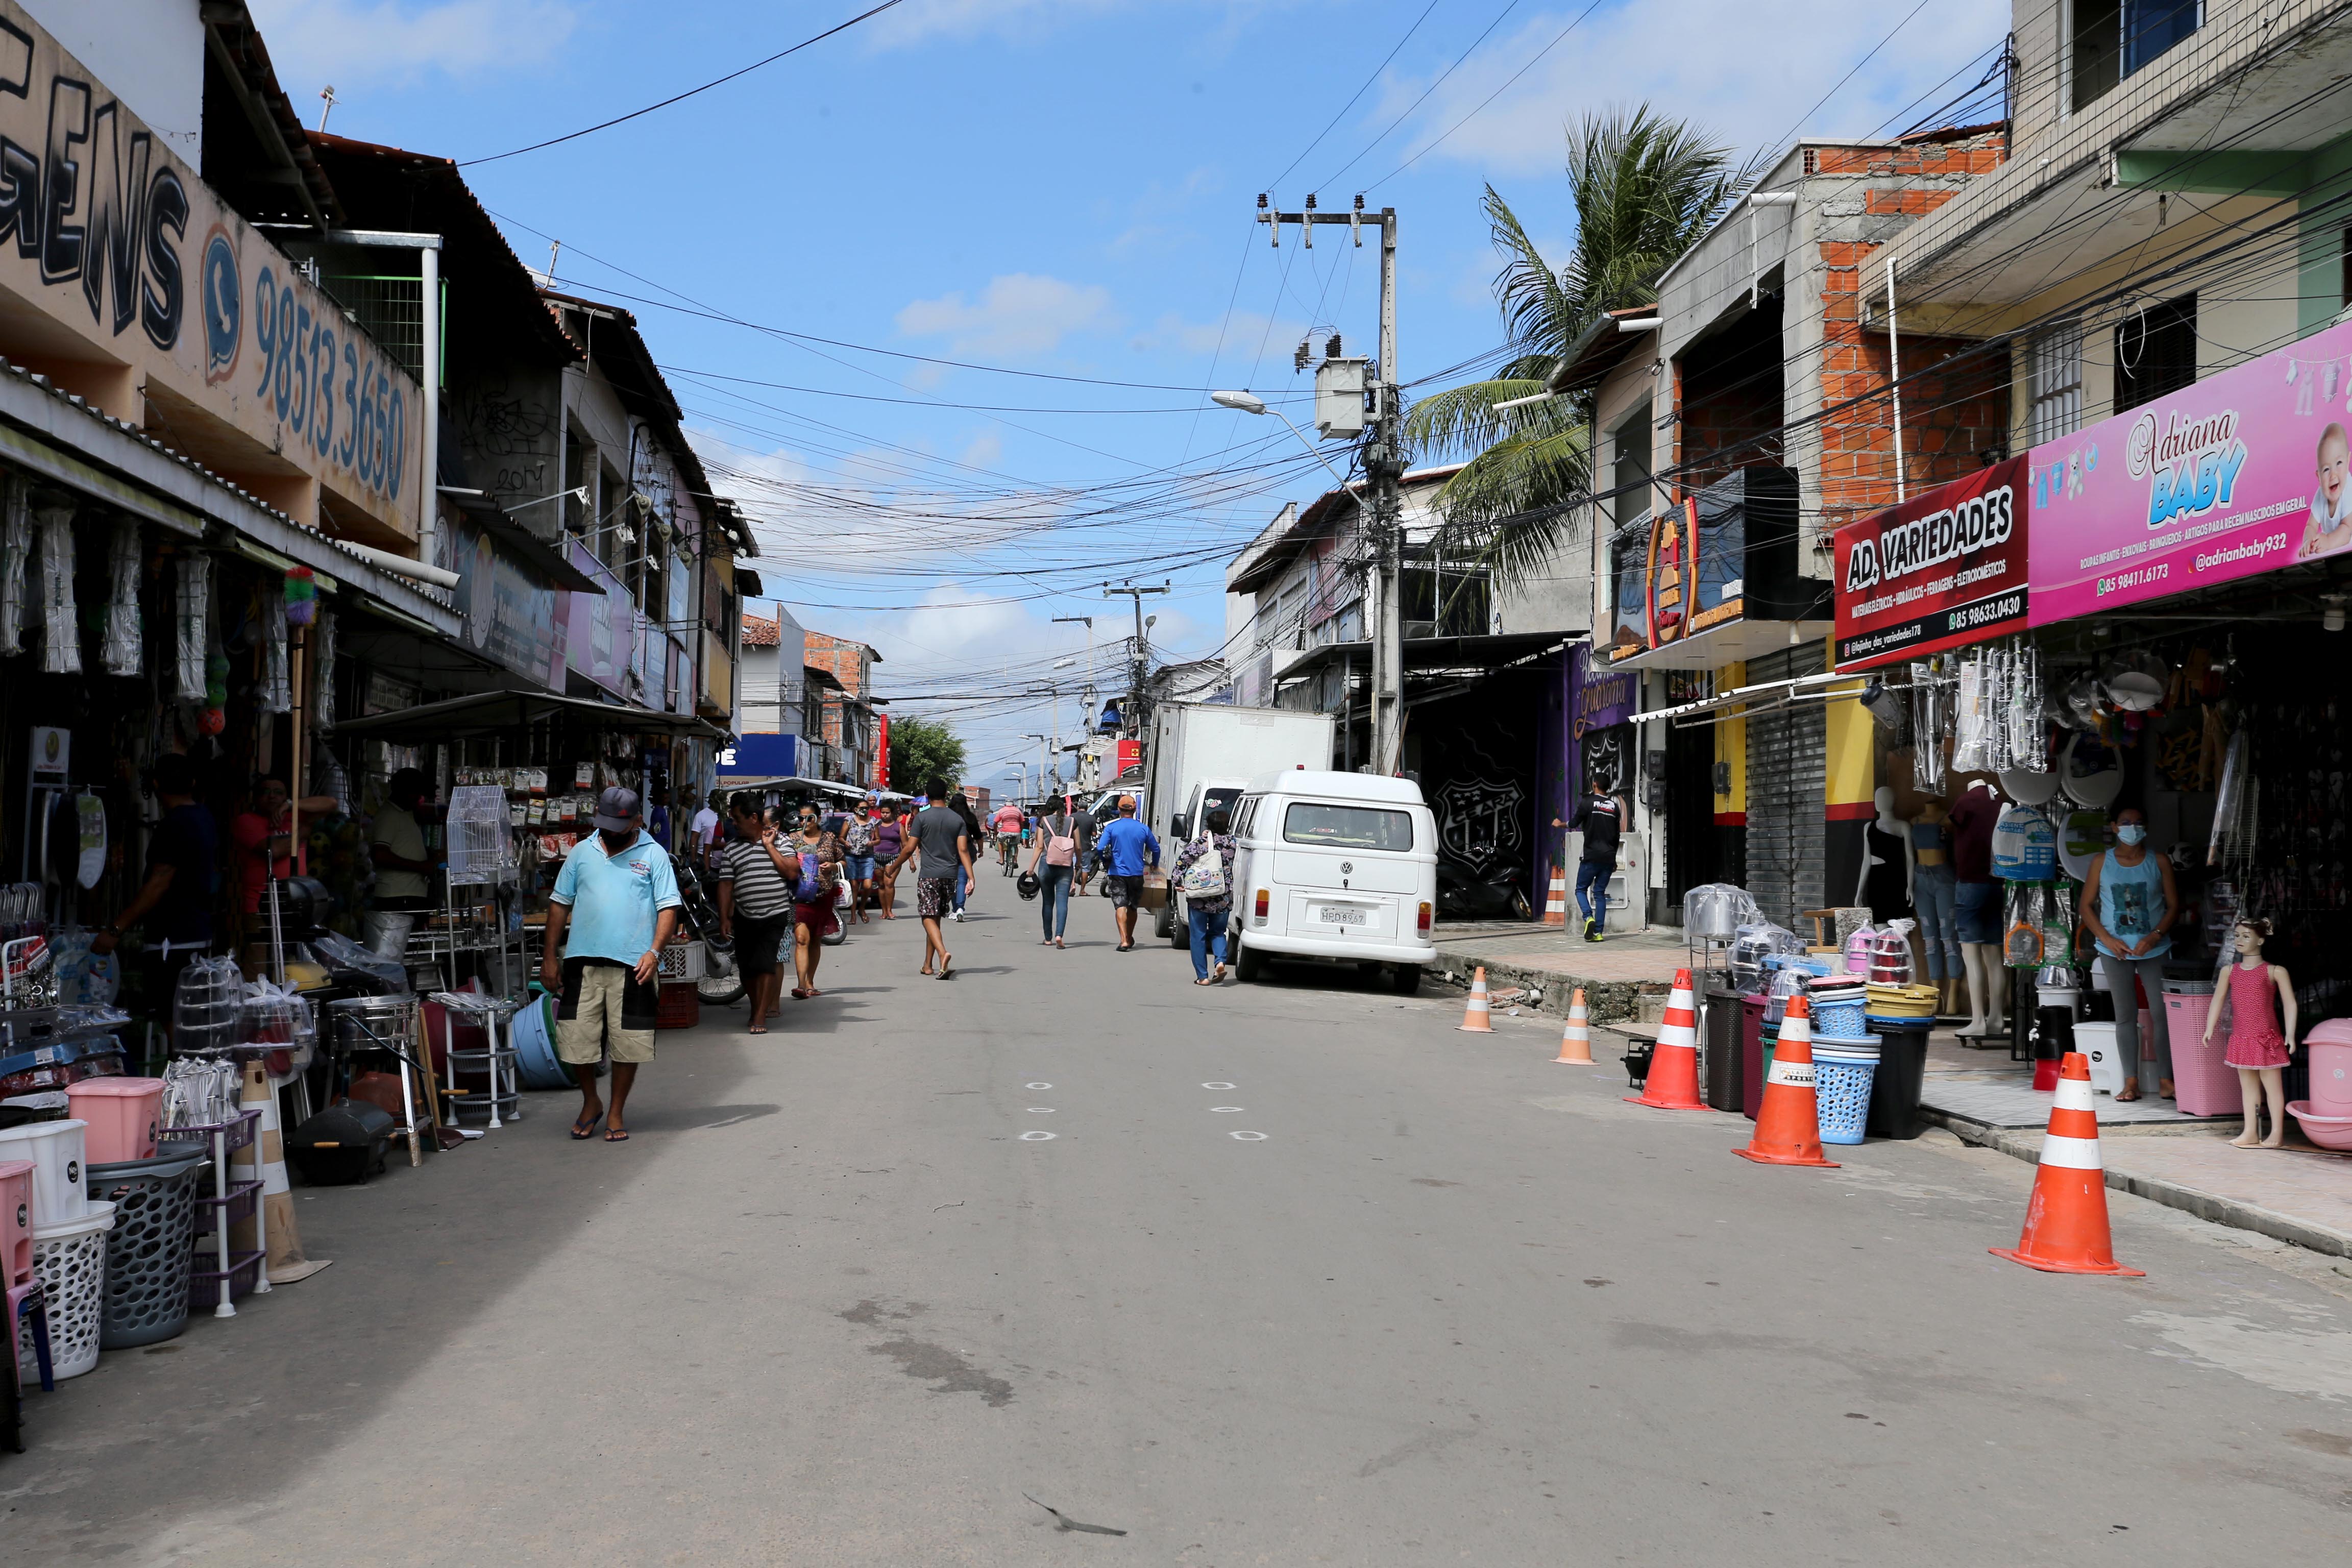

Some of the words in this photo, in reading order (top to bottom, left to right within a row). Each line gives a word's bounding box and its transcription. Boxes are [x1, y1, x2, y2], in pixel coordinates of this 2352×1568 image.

[2128, 413, 2236, 476] Adriana
[2149, 443, 2245, 525] BABY
[1882, 487, 2012, 577] VARIEDADES
[2080, 554, 2099, 570] ROUPAS
[2099, 549, 2120, 565] INFANTIS
[2122, 541, 2147, 558] ENXOVAIS
[2149, 531, 2182, 550] BRINQUEDOS
[2185, 525, 2208, 541] ARTIGOS
[2209, 520, 2224, 533] PARA
[2224, 511, 2245, 529] RECÉM
[2245, 505, 2275, 523] NASCIDOS
[2276, 501, 2285, 514] EM
[2286, 496, 2307, 512] GERAL
[2196, 532, 2286, 572] @adrianbaby932
[1852, 600, 1872, 619] MATERIAIS
[1872, 595, 1893, 613] ELÉTRICOS
[1896, 585, 1924, 605] HIDRÁULICOS
[1927, 575, 1953, 596] FERRAGENS
[1957, 559, 2006, 586] ELETRODOMÉSTICOS
[2105, 577, 2116, 593] 85
[2118, 563, 2168, 590] 98411.6173
[1956, 610, 1967, 628] 85
[1969, 596, 2020, 625] 98633.0430
